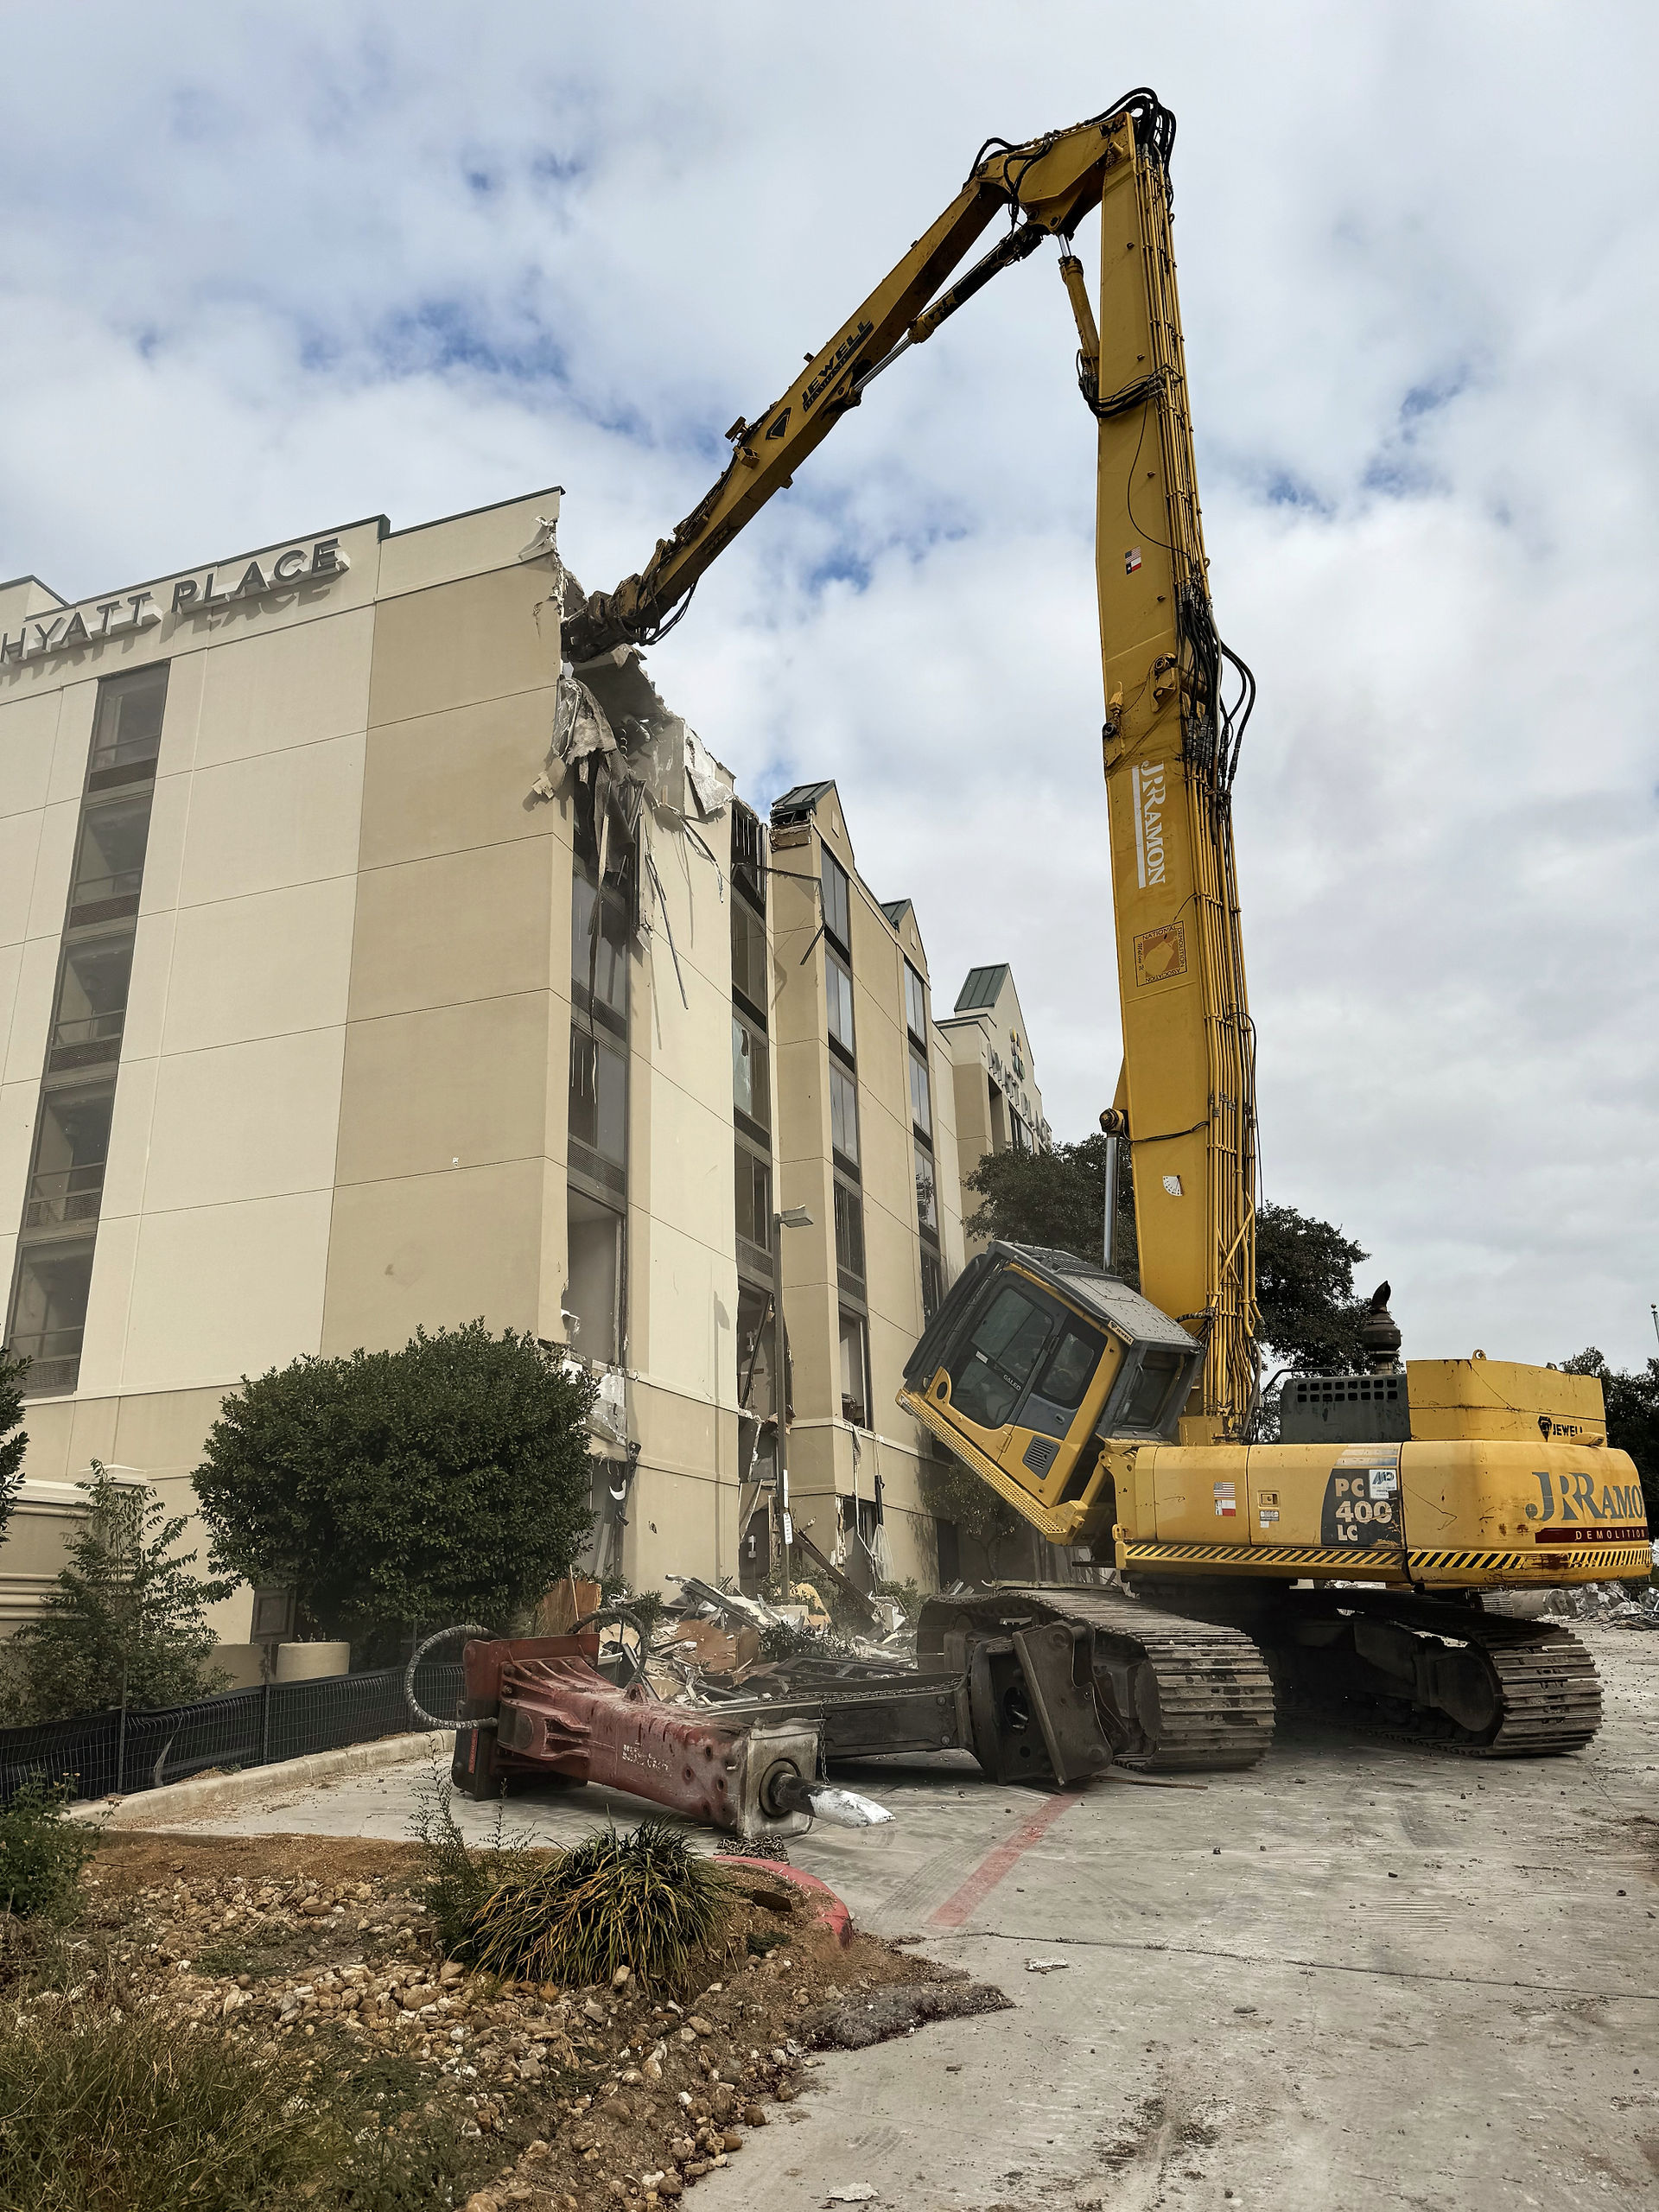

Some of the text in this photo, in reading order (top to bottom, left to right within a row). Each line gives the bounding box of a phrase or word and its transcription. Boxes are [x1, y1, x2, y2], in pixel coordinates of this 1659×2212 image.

[802, 321, 871, 404] JEWELL
[1, 537, 346, 664] HYATT PLACE
[1003, 1374, 1021, 1391] GALEO
[1334, 1478, 1365, 1497] PC
[1525, 1471, 1646, 1522] JRRAMO
[1335, 1500, 1393, 1524] 400
[1337, 1524, 1358, 1541] LC
[1575, 1529, 1645, 1541] DEMOLITION
